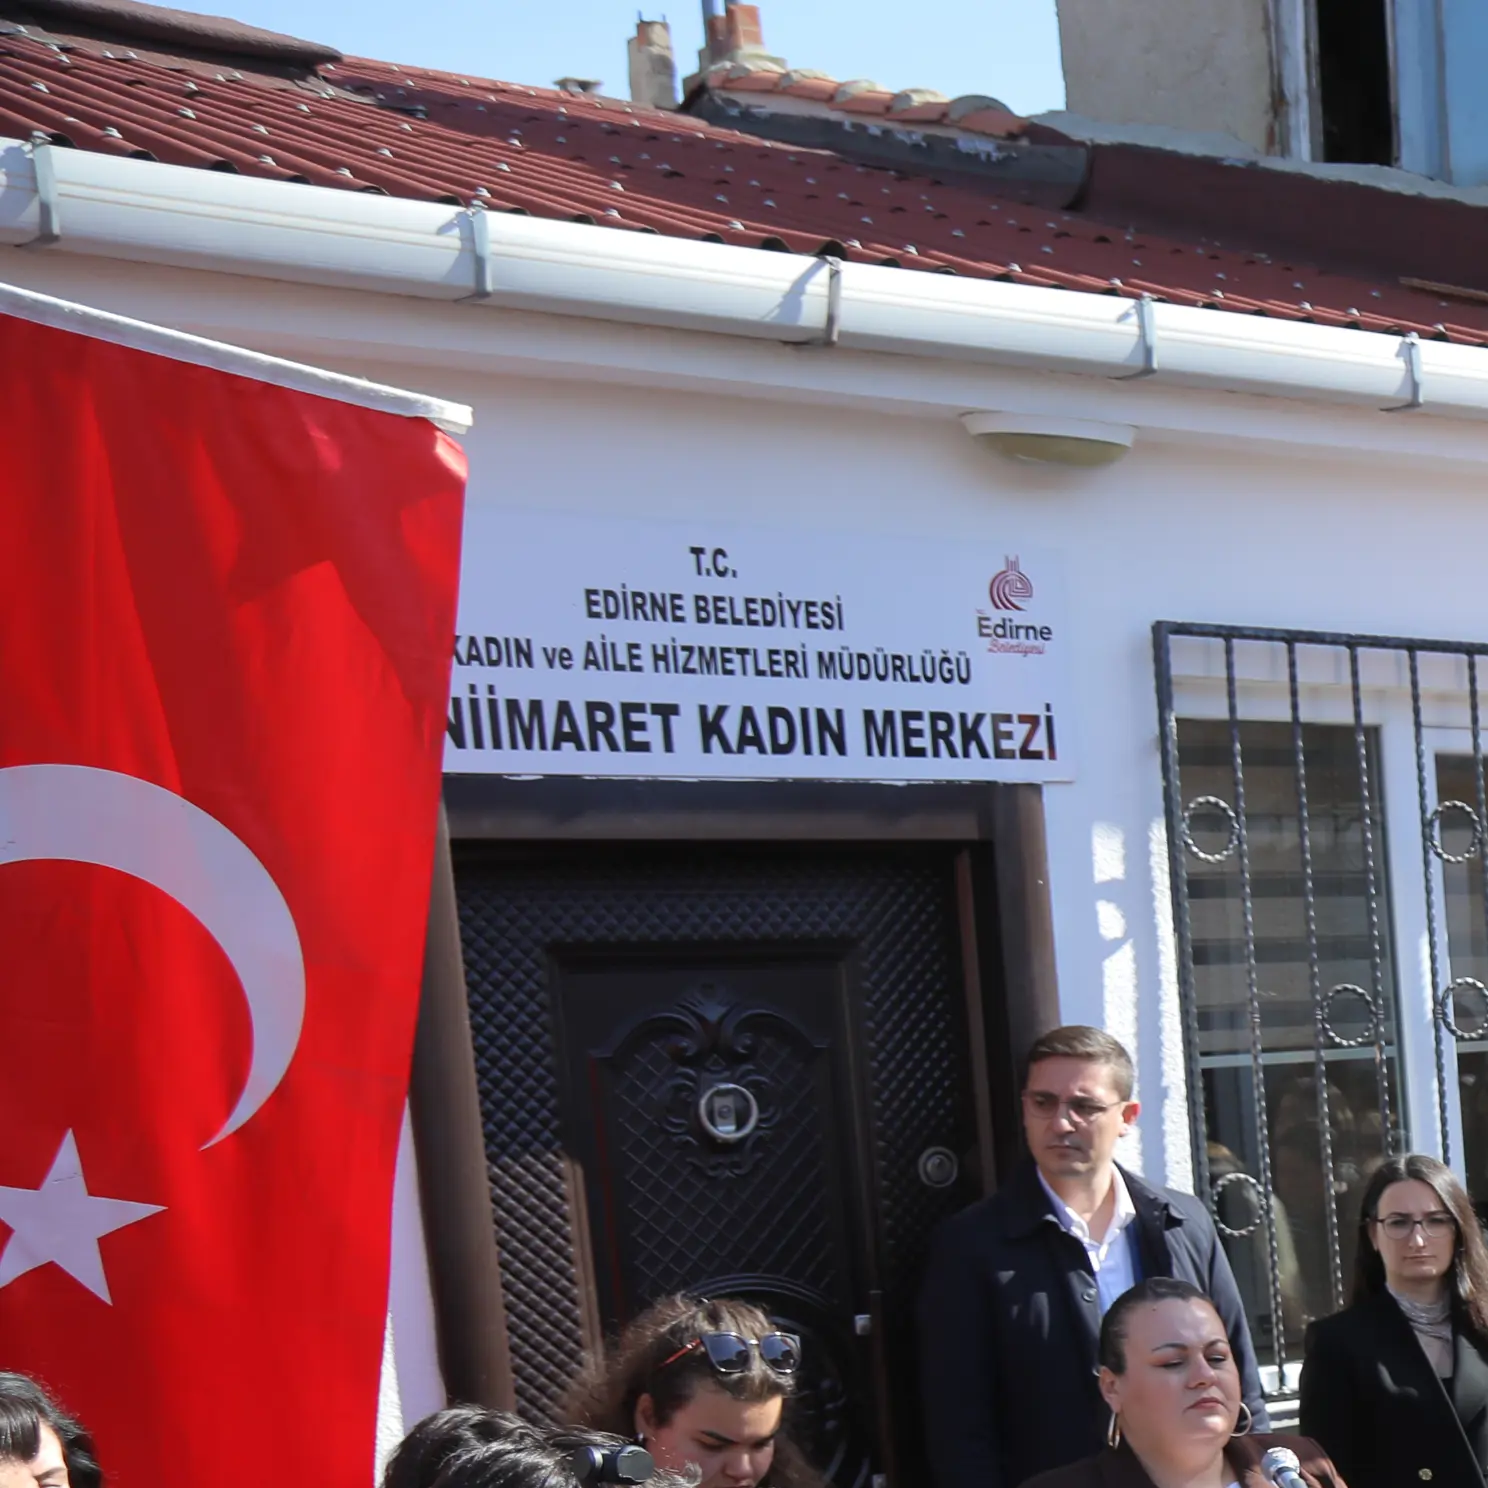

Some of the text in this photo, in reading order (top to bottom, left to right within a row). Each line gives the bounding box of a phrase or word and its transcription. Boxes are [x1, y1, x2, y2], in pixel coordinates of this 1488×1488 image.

[689, 546, 738, 578] T.C.
[584, 583, 845, 631] EDİRNE BELEDİYESİ
[977, 615, 1053, 641] Edirne
[543, 645, 574, 671] ve
[583, 633, 644, 673] AİLE
[651, 637, 809, 679] HİZMETLERİ
[818, 645, 972, 685] MÜDÜRLÜĞÜ
[698, 704, 848, 757] KADIN
[862, 702, 1058, 761] MERKEZİ
